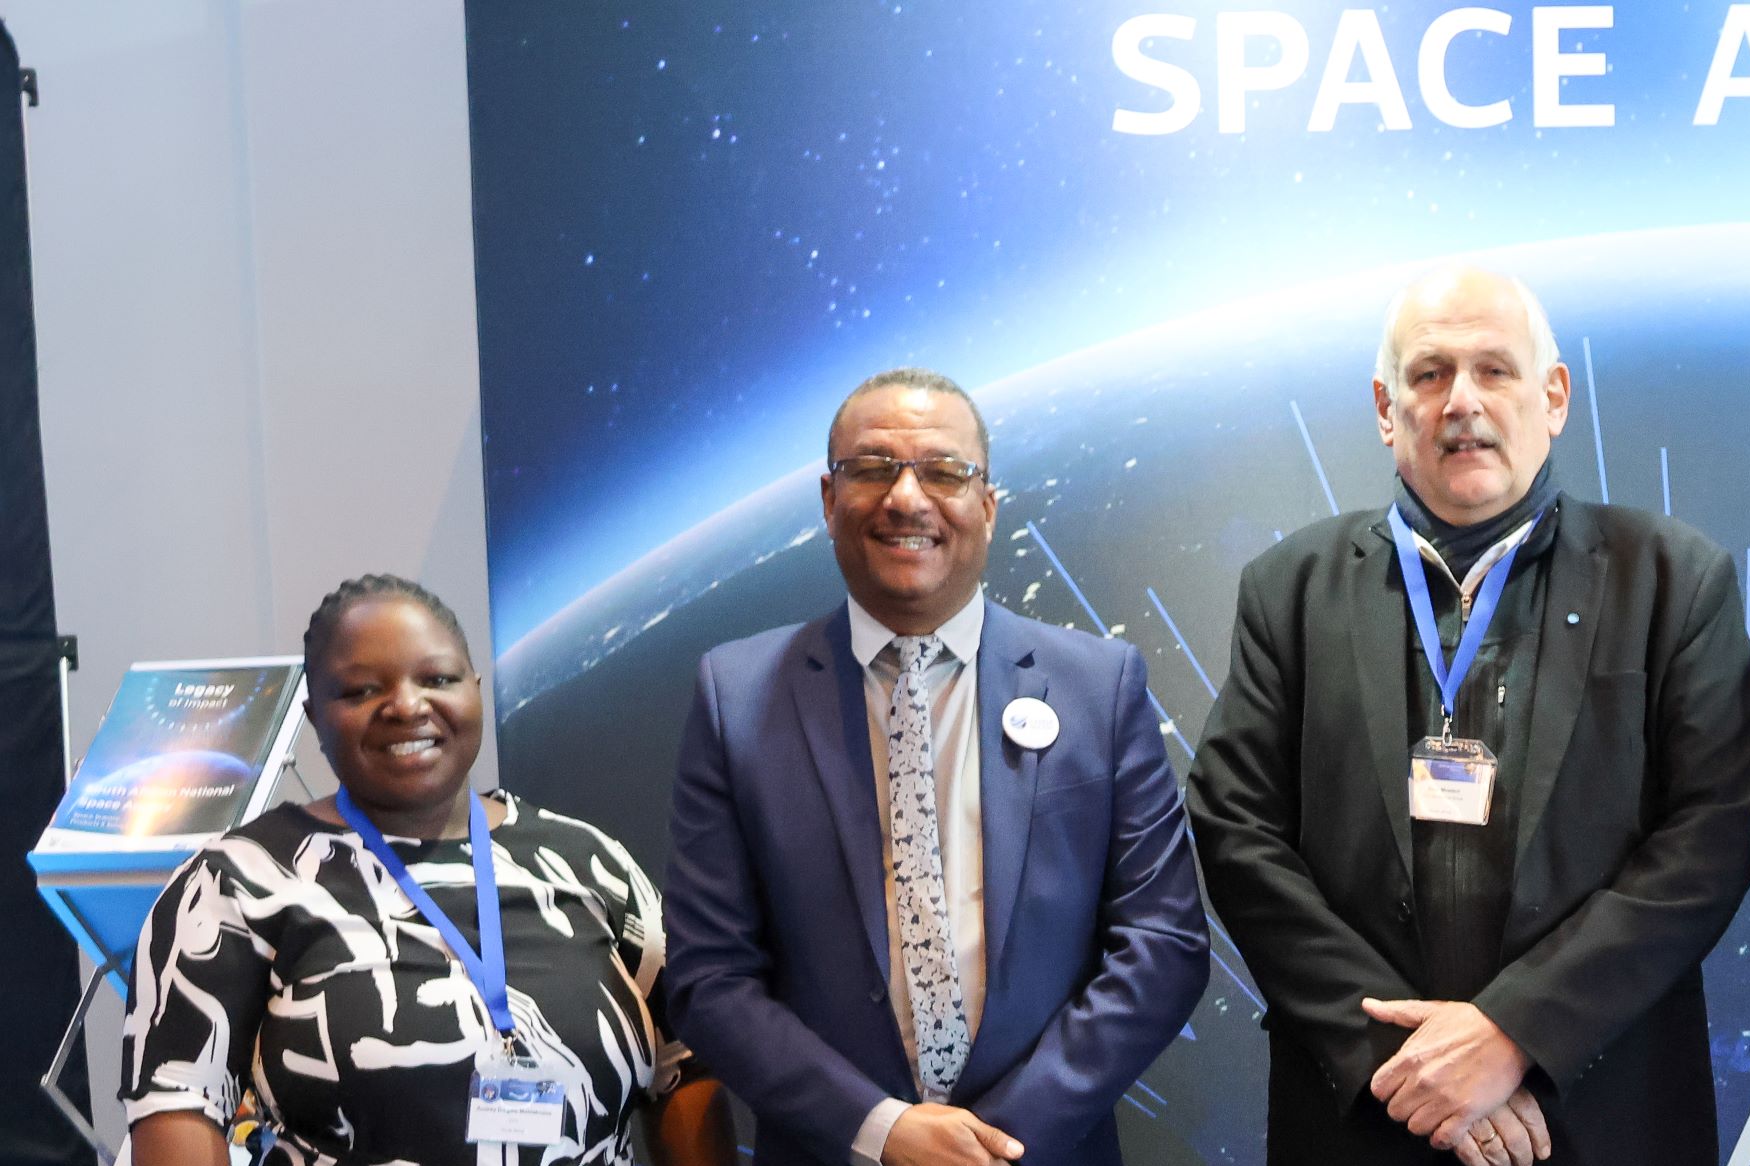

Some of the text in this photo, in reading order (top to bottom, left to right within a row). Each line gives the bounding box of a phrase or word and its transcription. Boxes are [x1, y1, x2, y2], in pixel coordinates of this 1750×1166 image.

[1111, 6, 1616, 136] SPACE
[174, 682, 235, 698] Legacy
[179, 784, 235, 797] National
